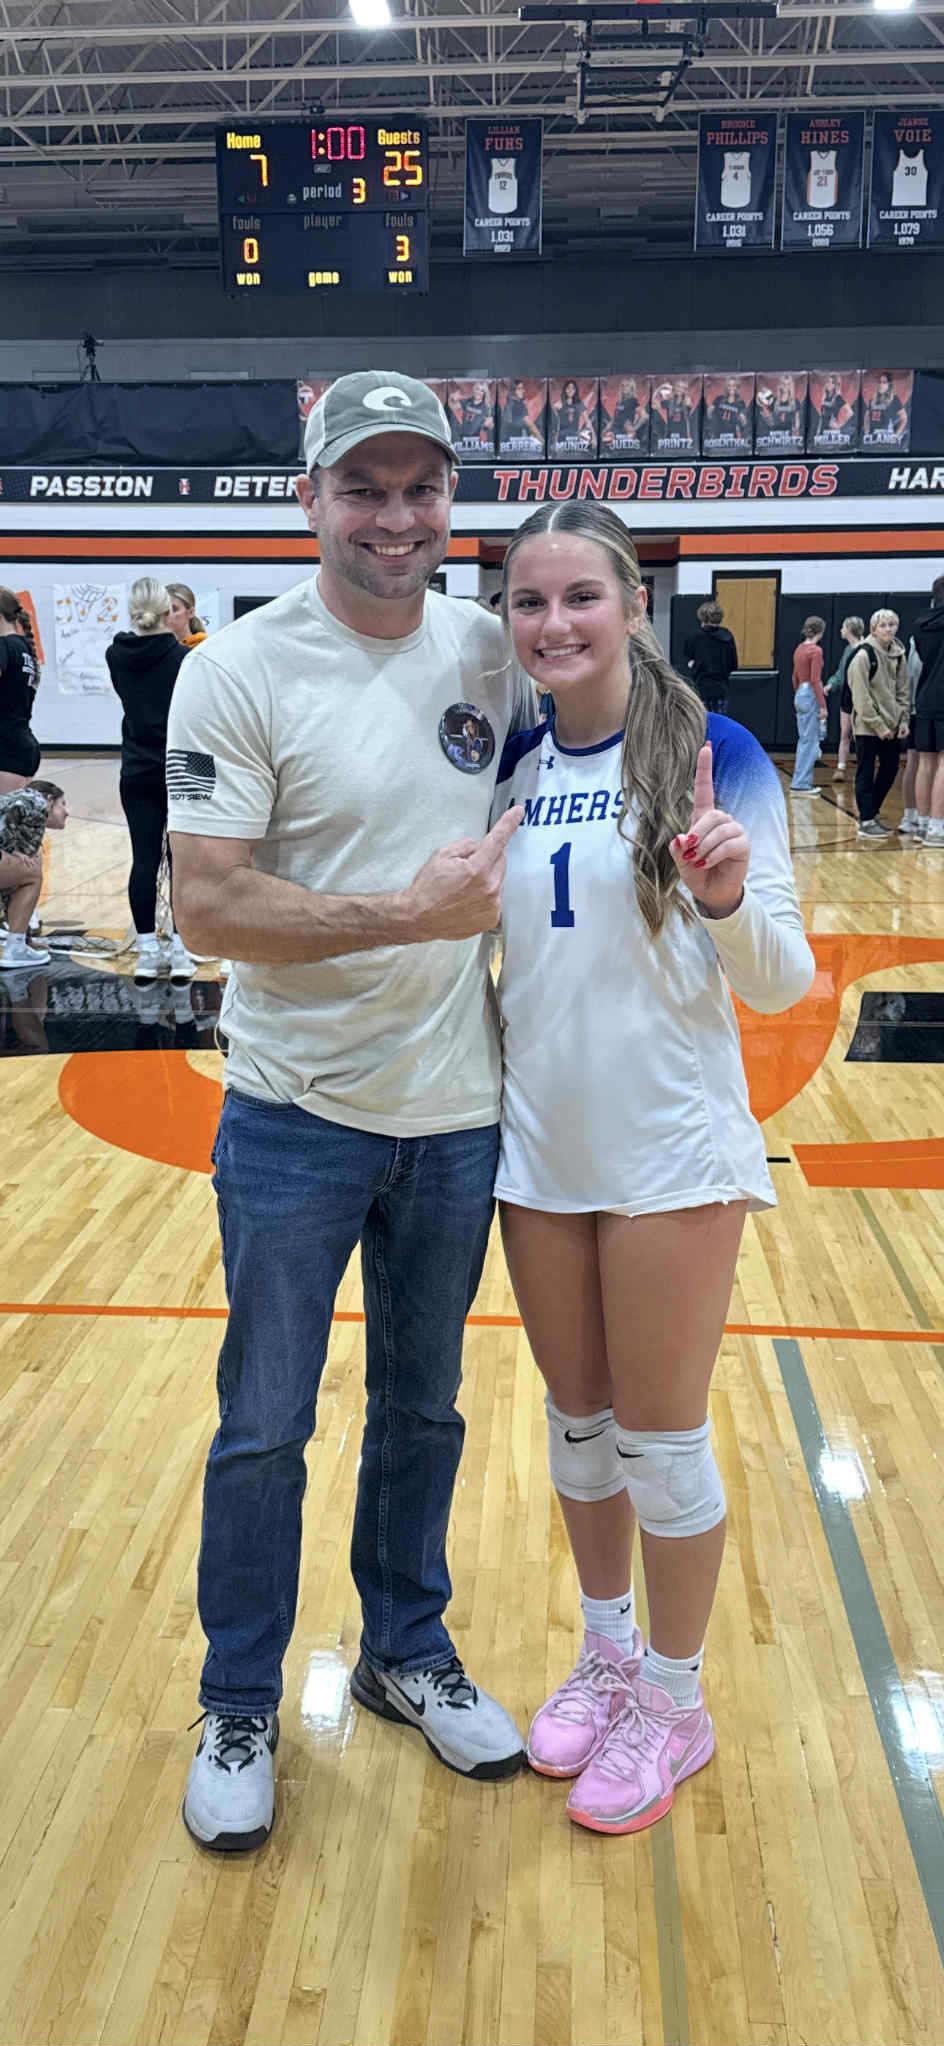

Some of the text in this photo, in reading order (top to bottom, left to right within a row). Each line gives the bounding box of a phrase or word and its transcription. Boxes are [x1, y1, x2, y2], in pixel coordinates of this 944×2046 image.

[378, 129, 420, 146] Guests
[487, 126, 521, 135] LILLIAN
[706, 131, 769, 145] PHILLIPS
[800, 130, 849, 144] HINES
[893, 128, 932, 143] VOIE
[227, 132, 261, 149] Home
[312, 126, 365, 160] 1:00
[485, 138, 524, 152] FUHS
[250, 154, 269, 187] 7
[382, 150, 423, 186] 25
[904, 166, 918, 176] 30
[816, 176, 828, 187] 21
[303, 177, 366, 204] period 3
[233, 214, 261, 230] fouls
[304, 213, 342, 231] player
[385, 212, 414, 228] fouls
[474, 215, 531, 228] CAREER POINTS
[706, 212, 764, 222] CAREER POINTS
[793, 211, 850, 221] CAREER POINTS
[879, 209, 937, 220] CAREER POINTS
[244, 237, 259, 264] 0
[396, 235, 410, 262] 3
[237, 271, 260, 286] won
[308, 270, 340, 287] game
[388, 270, 413, 284] won
[657, 438, 694, 449] PRINTZ
[29, 475, 154, 497] PASSION
[493, 465, 840, 500] THUNDERBIRDS
[889, 467, 944, 490] HAR
[550, 842, 575, 927] 1
